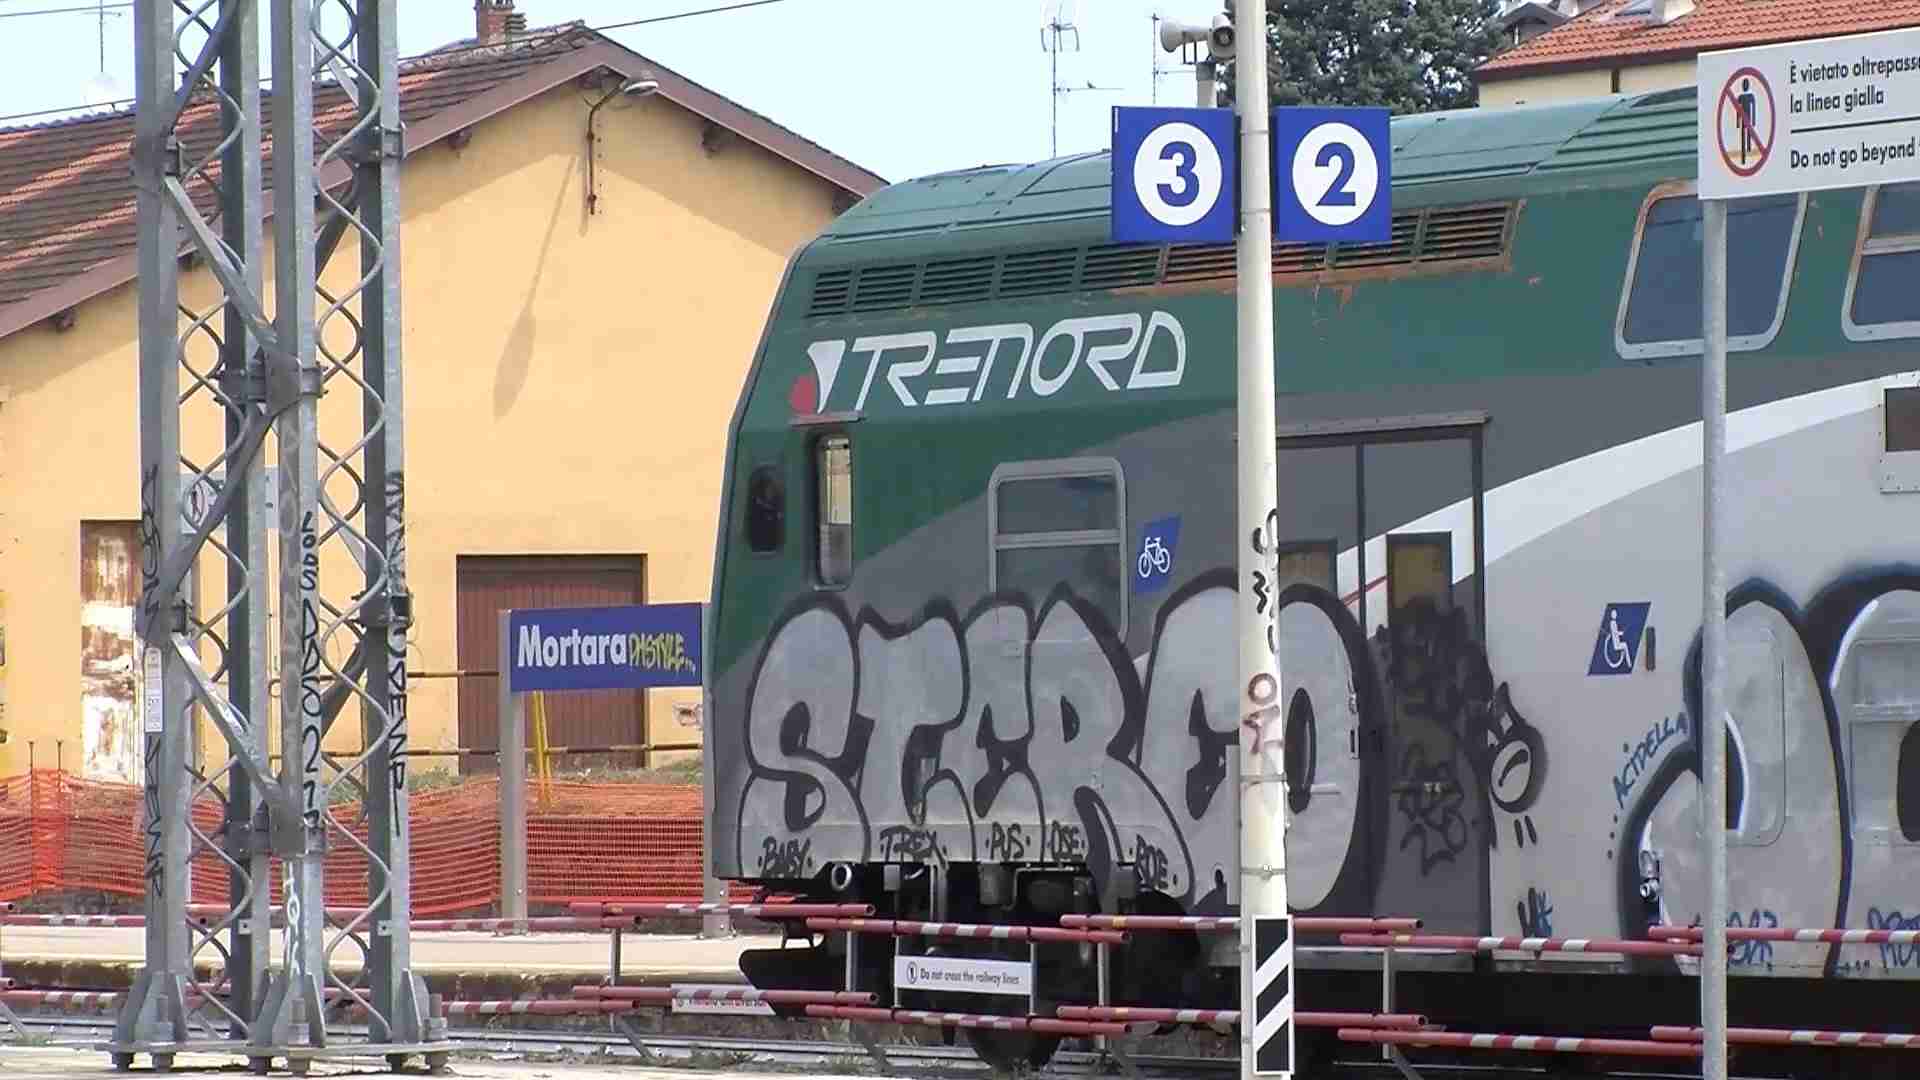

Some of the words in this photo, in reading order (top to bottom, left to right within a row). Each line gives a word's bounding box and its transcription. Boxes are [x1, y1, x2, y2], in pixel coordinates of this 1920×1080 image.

[1800, 62, 1849, 82] vietato
[1790, 93, 1802, 113] la
[1806, 91, 1841, 112] linea
[1844, 84, 1884, 112] gialla
[1790, 149, 1809, 169] Do
[1813, 147, 1835, 167] not
[1839, 149, 1858, 169] go
[1861, 136, 1916, 166] beyond
[1156, 140, 1200, 208] 3
[1314, 140, 1357, 207] 2
[850, 310, 1187, 411] TRENORD
[517, 623, 627, 668] Mortara
[919, 967, 930, 980] Do
